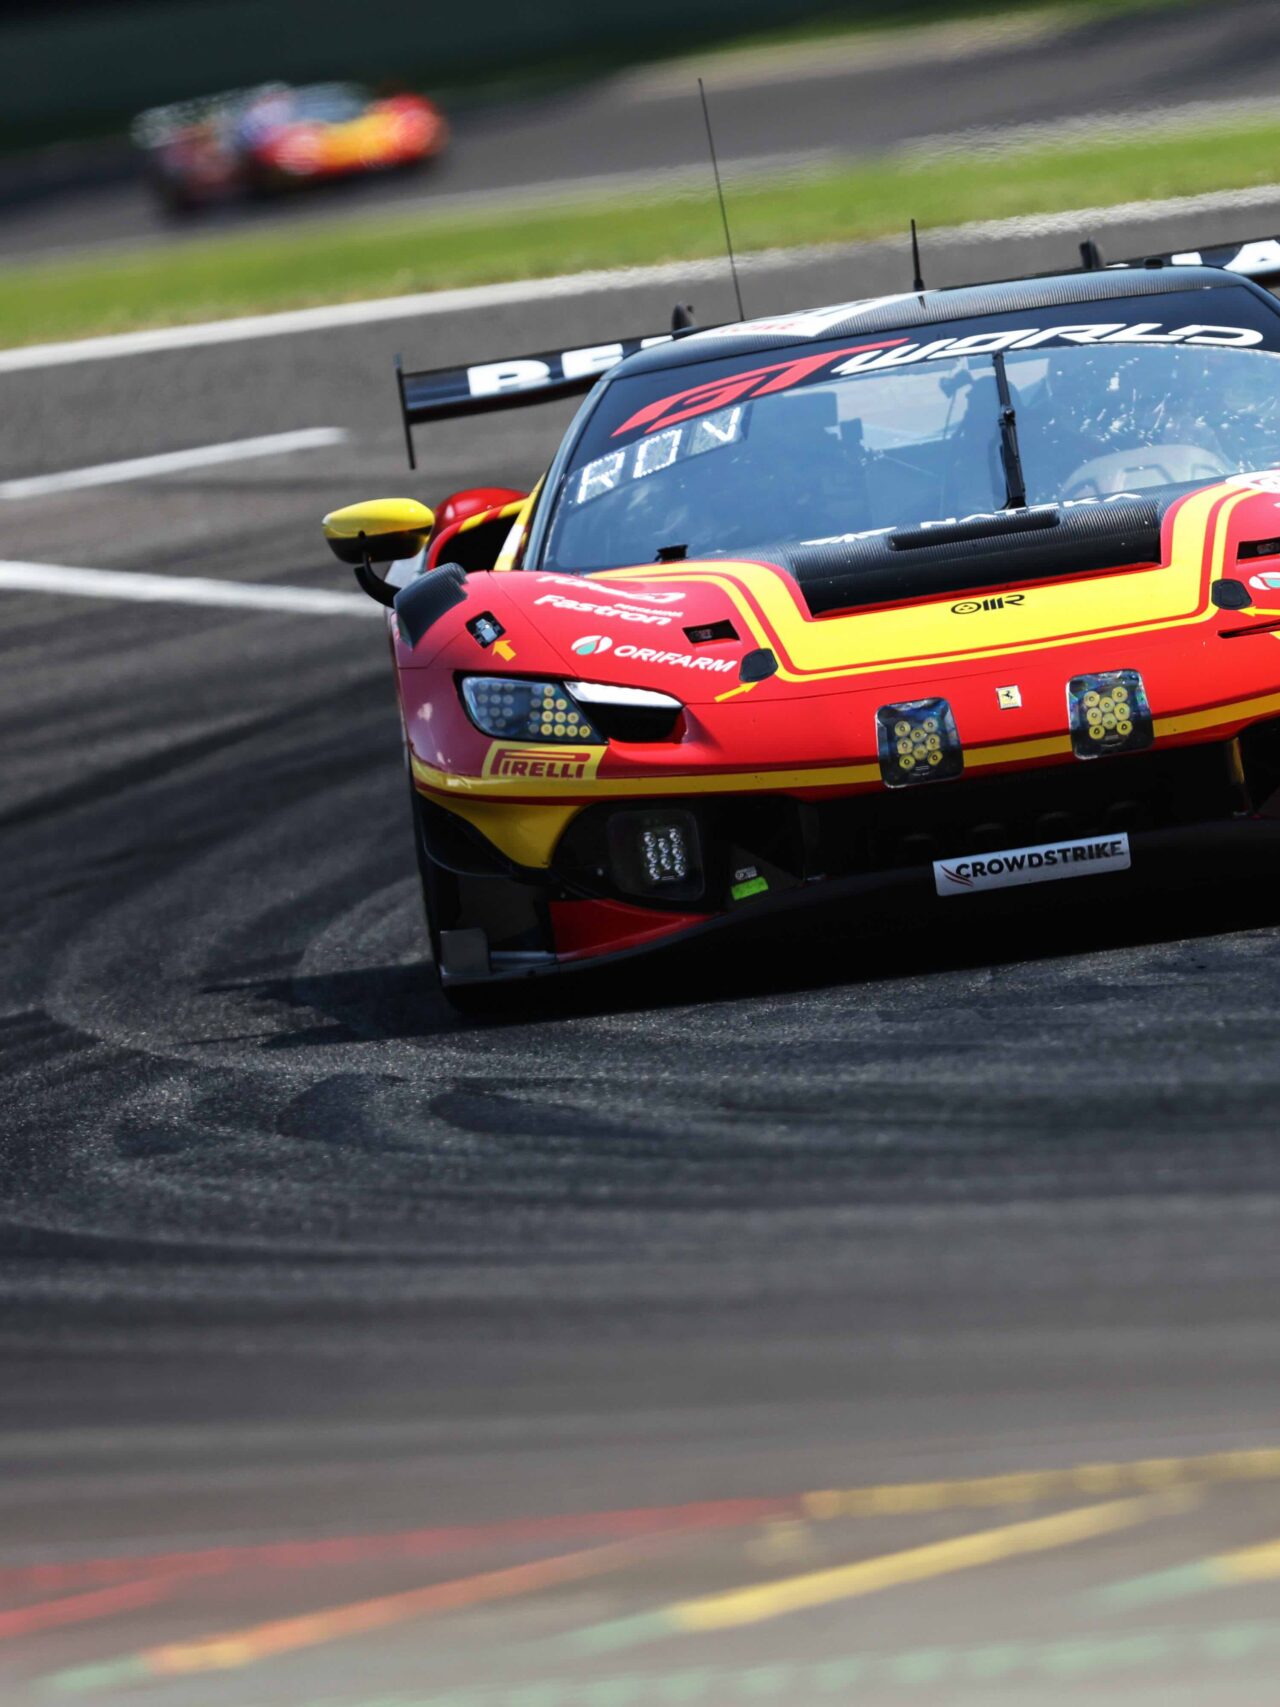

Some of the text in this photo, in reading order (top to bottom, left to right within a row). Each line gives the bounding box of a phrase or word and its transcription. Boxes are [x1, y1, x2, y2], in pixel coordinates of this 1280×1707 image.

[534, 594, 672, 626] Fastron
[613, 644, 738, 673] ORIFARM
[489, 748, 592, 779] PIRELLI
[955, 840, 1125, 879] CROWDSTRIKE
